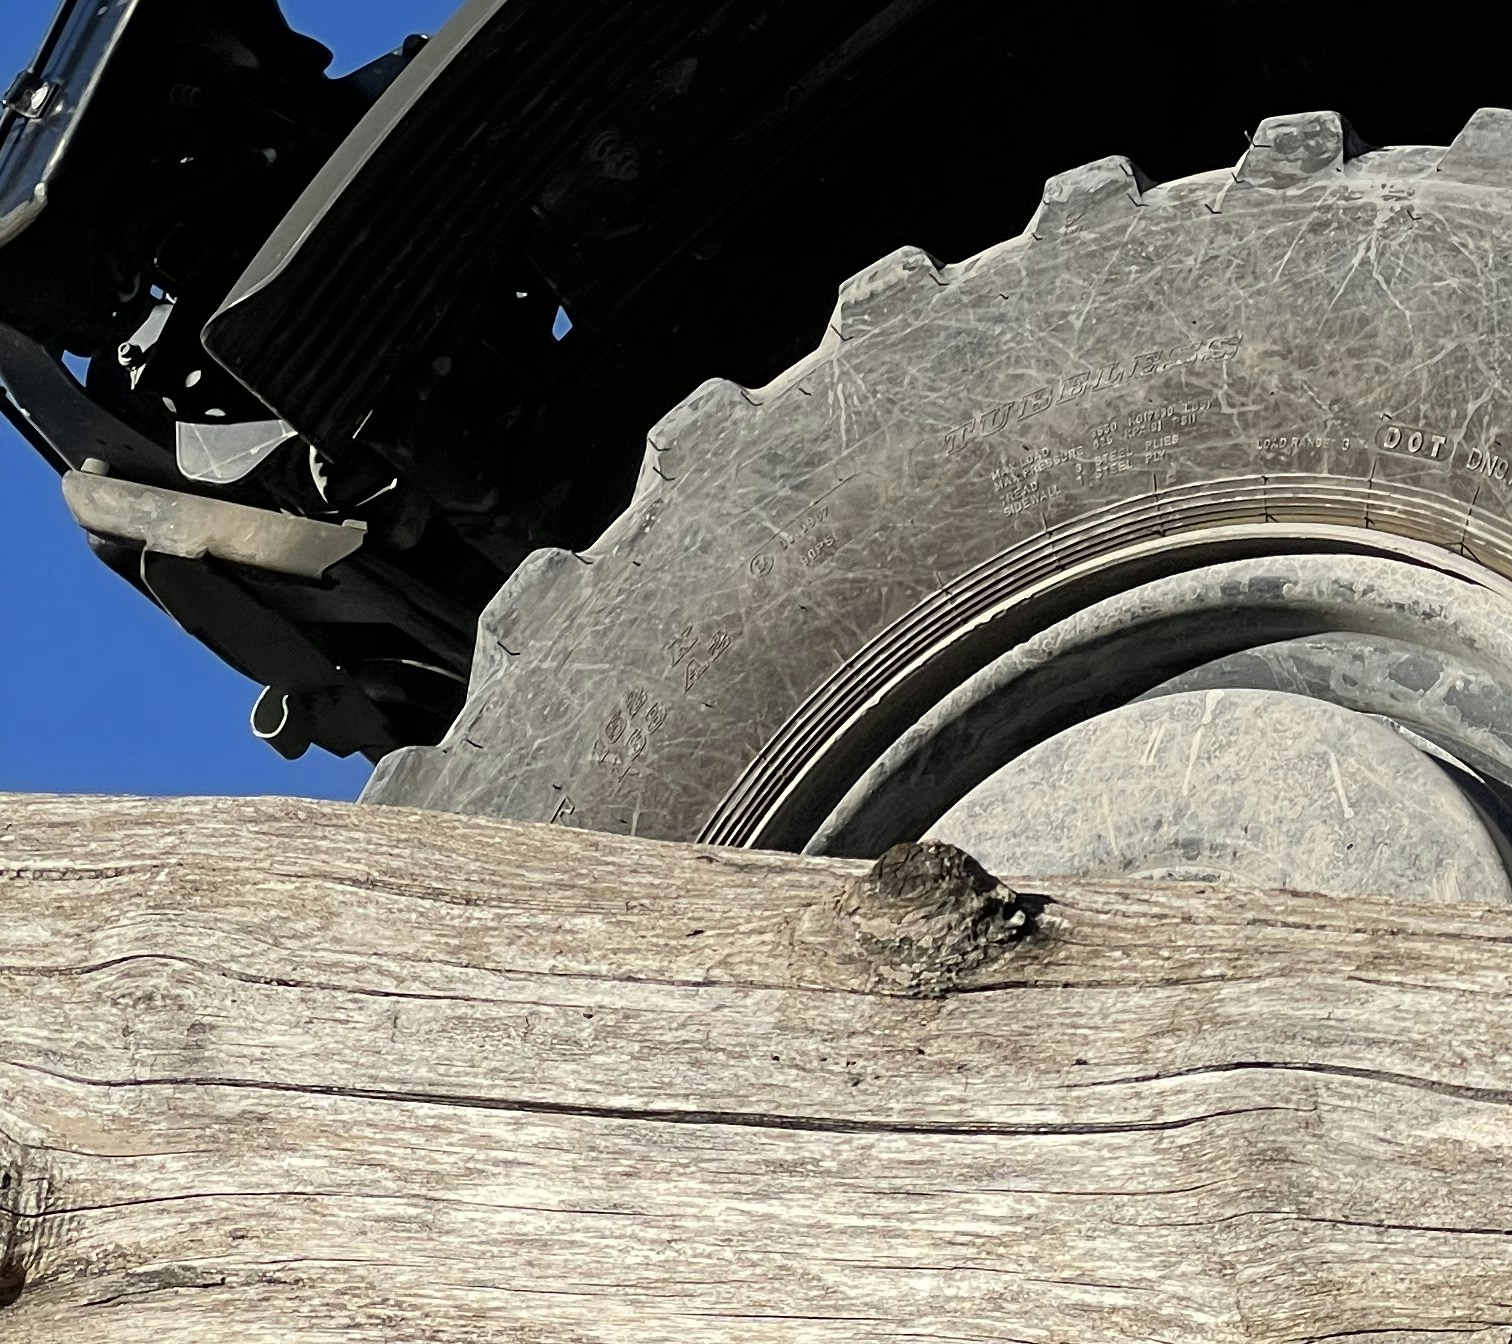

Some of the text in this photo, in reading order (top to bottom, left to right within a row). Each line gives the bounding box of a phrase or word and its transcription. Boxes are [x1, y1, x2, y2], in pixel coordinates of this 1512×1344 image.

[945, 330, 1243, 456] TUBELESS
[1020, 446, 1051, 469] LOAD
[1255, 437, 1287, 451] LOAD
[1382, 426, 1447, 458] DOT
[1000, 480, 1039, 507] TREAD
[1094, 447, 1134, 467] STEEL
[1144, 433, 1180, 452] PLIES
[1003, 483, 1063, 518] SIDEWALL
[1093, 459, 1135, 481] STEEL
[1144, 448, 1168, 464] PLY
[1022, 445, 1084, 484] PRESSURE
